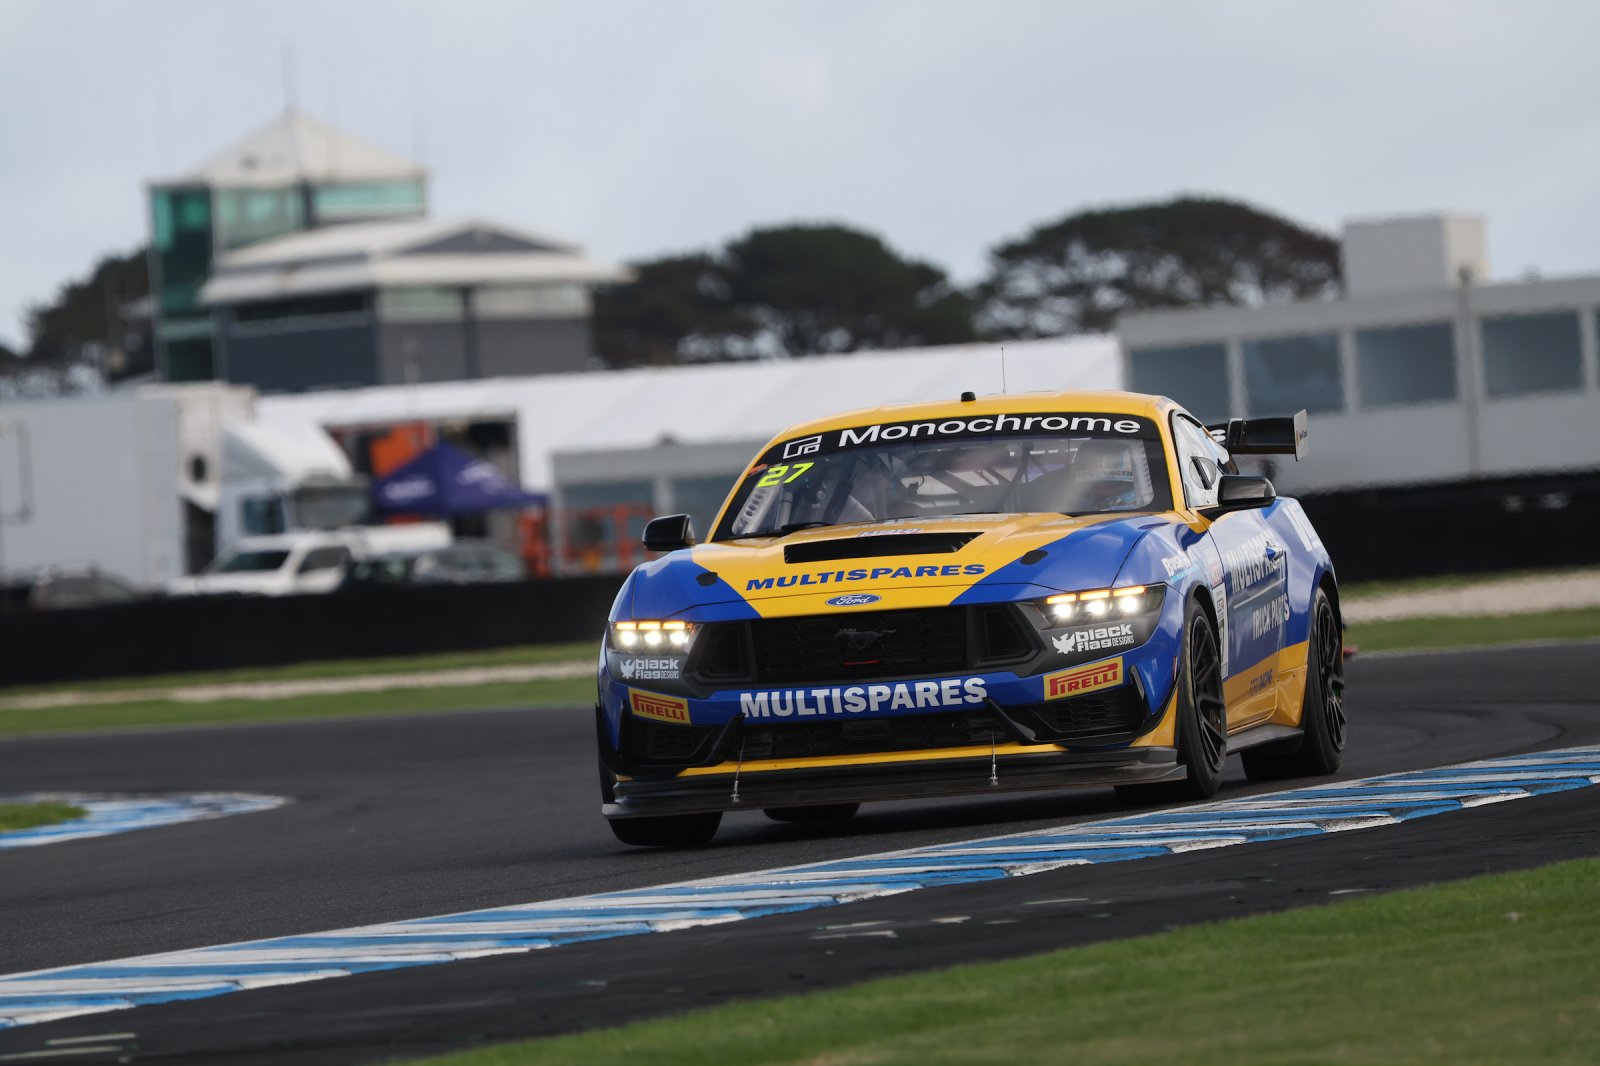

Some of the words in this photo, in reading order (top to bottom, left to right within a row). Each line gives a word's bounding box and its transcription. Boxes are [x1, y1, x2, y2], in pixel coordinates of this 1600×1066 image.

[838, 413, 1142, 448] Monochrome
[756, 461, 815, 489] 27
[745, 564, 987, 591] MULTISPARES
[835, 593, 871, 606] Ford
[1074, 623, 1133, 643] black
[1252, 601, 1271, 641] TRUCK
[1076, 638, 1112, 653] flag
[635, 658, 679, 670] black
[635, 670, 661, 680] flag
[1049, 662, 1119, 697] PIRELLI
[632, 692, 686, 721] PIRELLI
[739, 677, 989, 719] MULTISPARES
